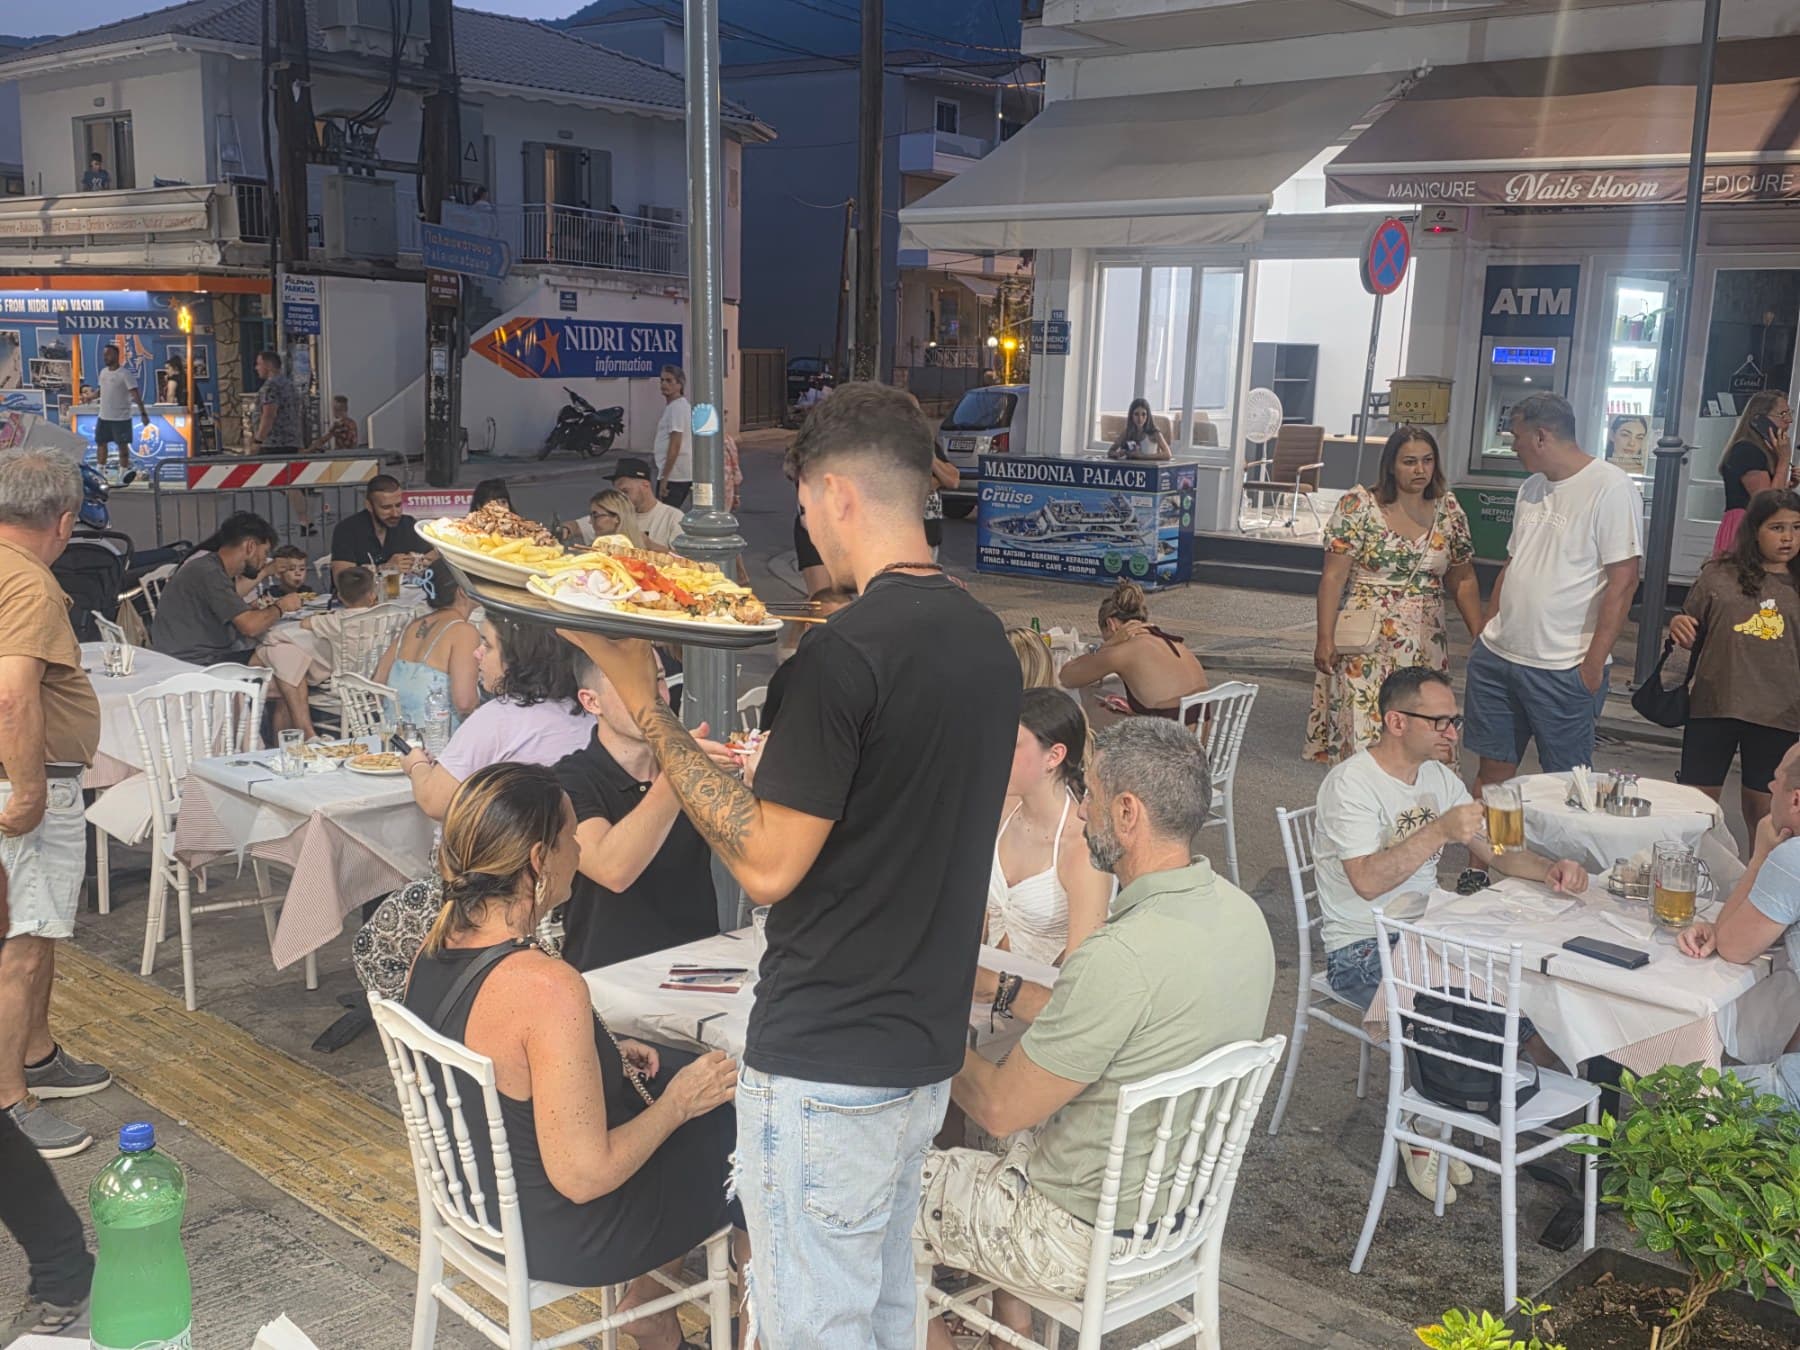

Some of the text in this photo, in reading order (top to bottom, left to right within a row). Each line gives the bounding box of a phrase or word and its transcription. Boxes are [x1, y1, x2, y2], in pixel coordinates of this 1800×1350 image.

[1387, 173, 1794, 203] MANICURE Nails bloom EDICURE
[5, 298, 25, 313] FROM
[28, 299, 49, 313] NIDRI
[1490, 287, 1572, 315] ATM
[65, 315, 171, 331] NIDRI STAR
[563, 325, 678, 353] NIDRI STAR
[595, 356, 653, 376] information
[1398, 401, 1427, 409] POST
[984, 461, 1075, 483] MAKEDONIA
[1083, 467, 1147, 488] PALACE
[407, 495, 451, 506] STATHIS
[981, 487, 1034, 505] Cruise
[980, 546, 1000, 555] PORTO
[1065, 556, 1100, 566] KEFALONIA
[983, 555, 1005, 564] ITHACA
[1045, 562, 1062, 571] CAVE
